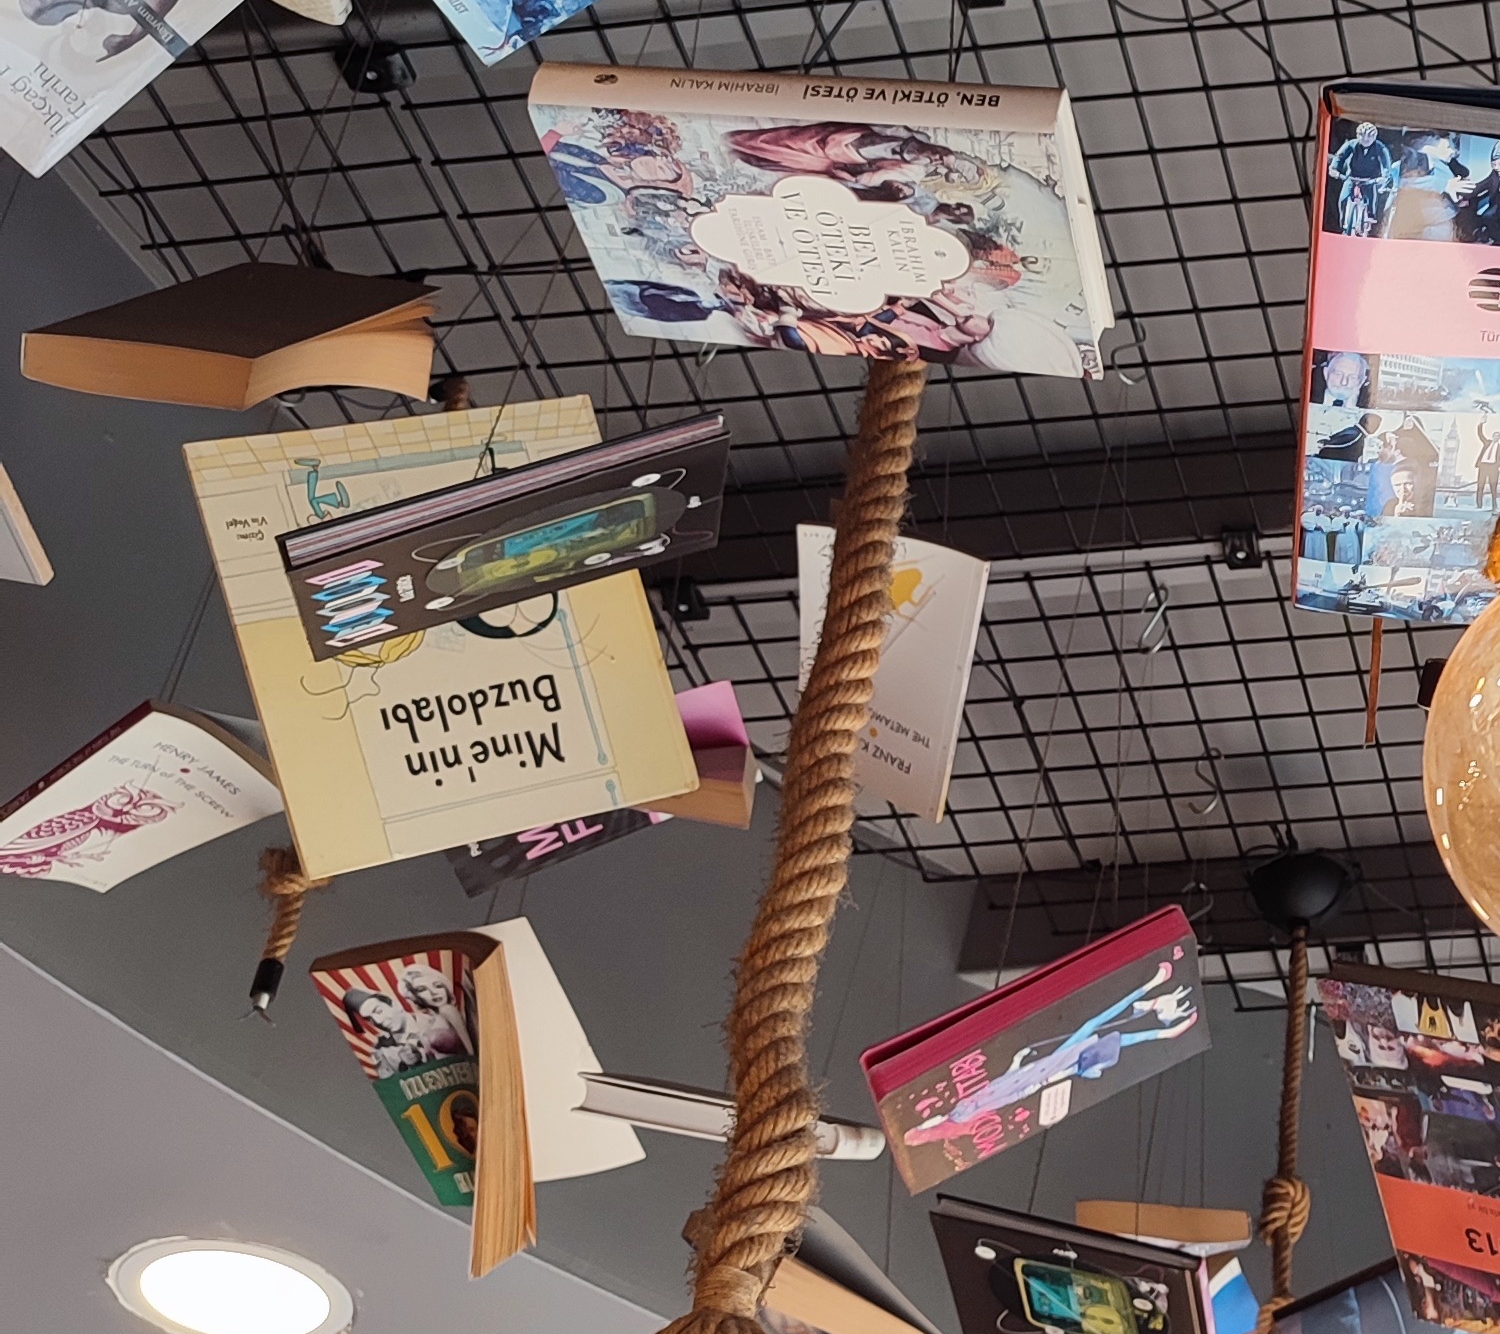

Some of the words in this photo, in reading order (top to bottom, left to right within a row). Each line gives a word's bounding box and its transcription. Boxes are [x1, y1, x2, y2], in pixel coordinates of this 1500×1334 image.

[668, 76, 714, 91] KALIN
[716, 79, 780, 96] İBRAHİM
[802, 83, 858, 103] ÖTESİ
[862, 86, 887, 101] VE
[891, 87, 949, 107] ÖTEKİ
[953, 90, 1001, 107] BEN,
[778, 189, 808, 223] VE
[790, 228, 837, 298] ÖTESİ
[814, 210, 860, 282] ÖTEKİ
[846, 221, 881, 274] BEN,
[885, 226, 909, 274] KALIN
[898, 219, 928, 283] İBRAHİM
[378, 673, 561, 743] Buzdolabı
[403, 723, 565, 787] Mine'nin
